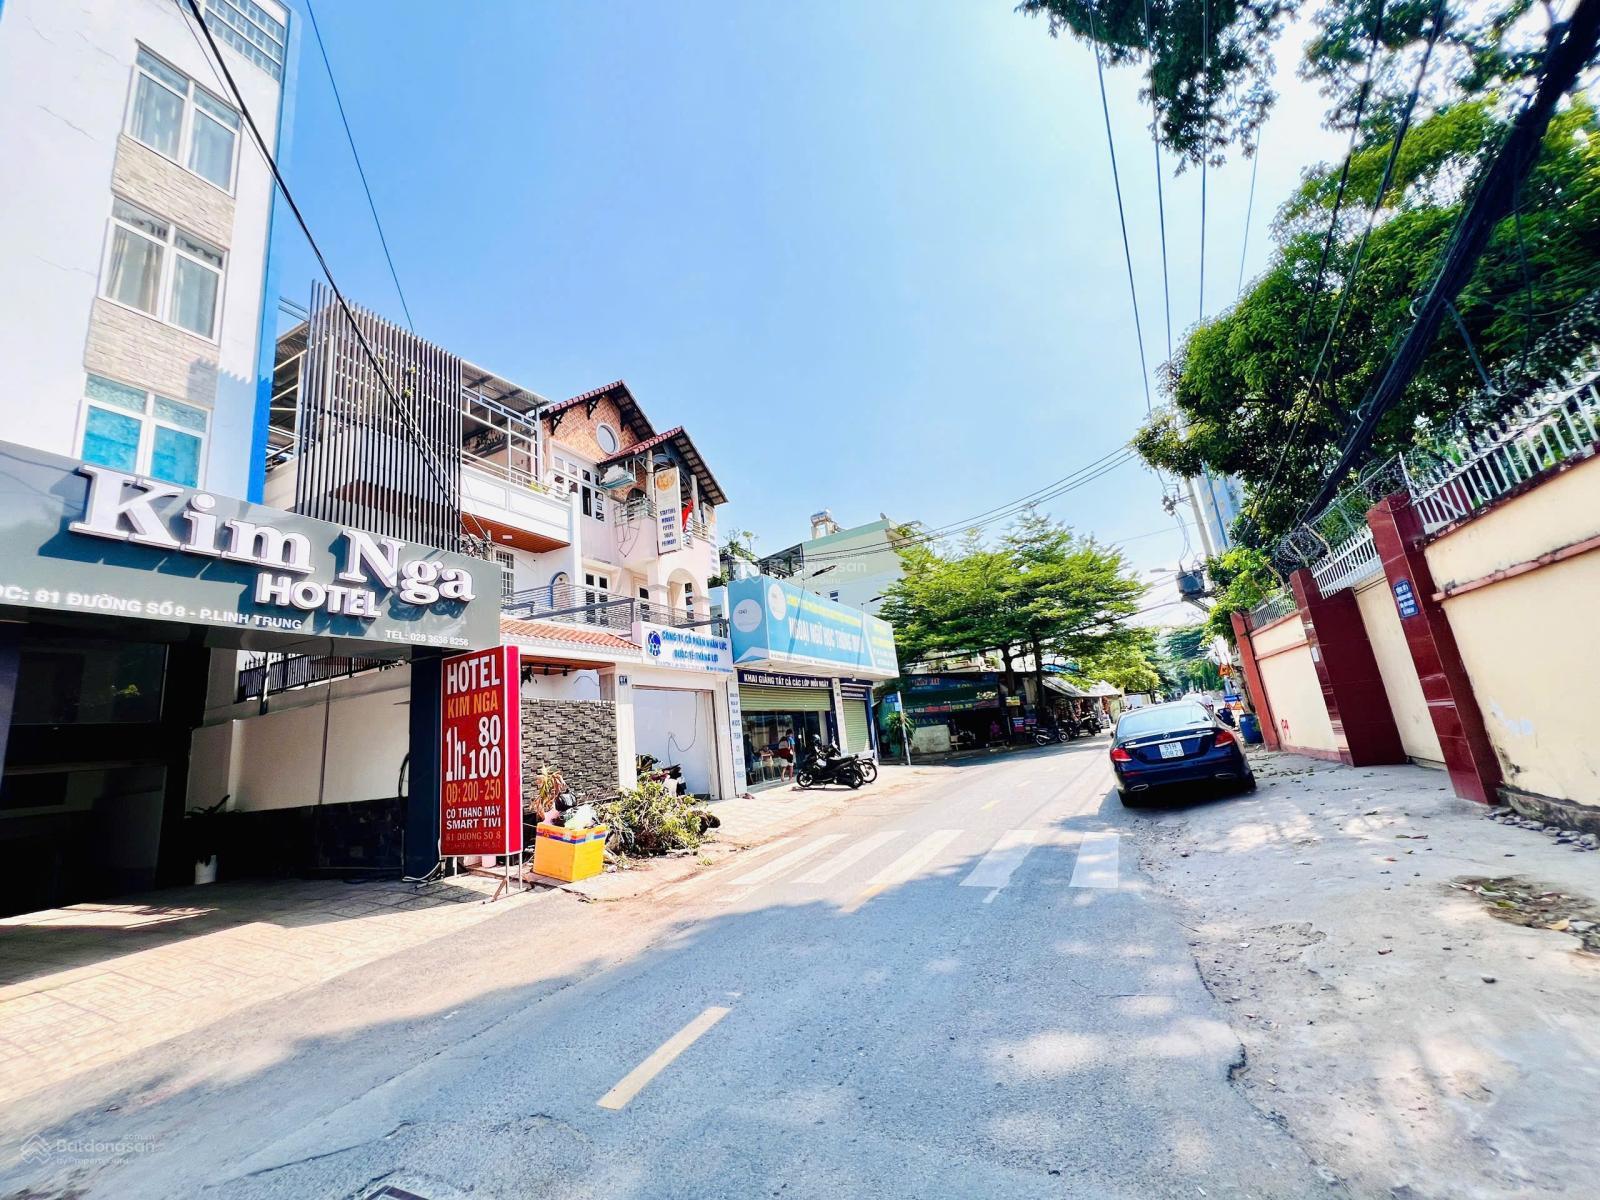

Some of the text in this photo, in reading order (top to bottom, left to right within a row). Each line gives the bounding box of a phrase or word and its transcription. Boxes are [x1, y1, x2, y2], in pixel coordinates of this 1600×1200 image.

[68, 464, 476, 605] Kim Nga
[34, 589, 60, 603] 81
[65, 592, 142, 613] ĐƯỜNG
[253, 613, 302, 629] TRUNG
[255, 572, 382, 618] HOTEL
[385, 629, 408, 640] TEL:
[447, 654, 500, 695] HOTEL
[743, 673, 758, 683] KHAI
[448, 690, 498, 719] KIM NGA
[478, 714, 501, 747] 80
[446, 726, 501, 782] 1h: 100
[462, 781, 479, 802] 200
[484, 778, 501, 800] 250
[446, 803, 501, 819] CÓ THANG MÁY
[446, 817, 501, 830] SMART TIVI
